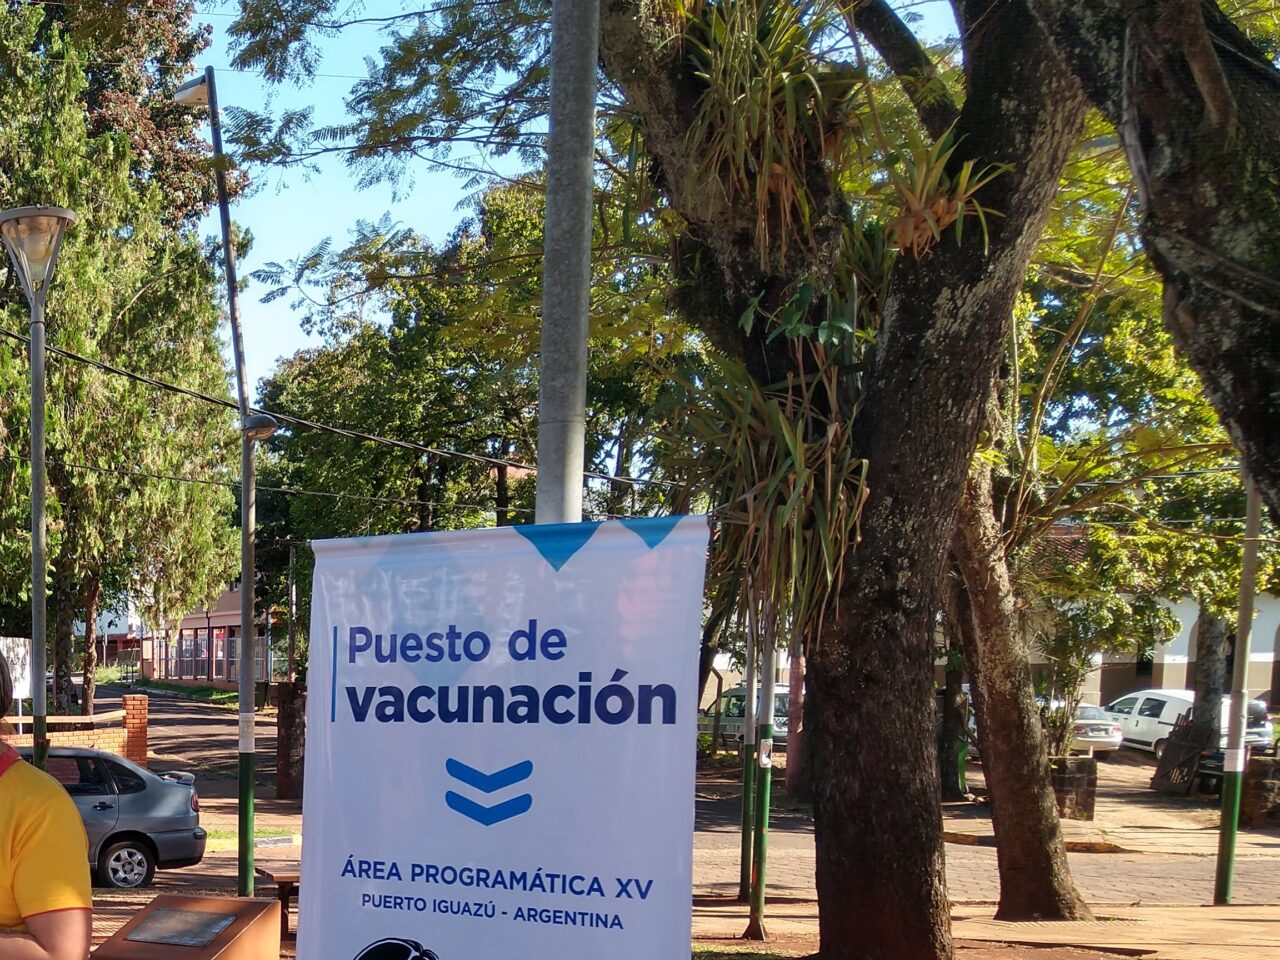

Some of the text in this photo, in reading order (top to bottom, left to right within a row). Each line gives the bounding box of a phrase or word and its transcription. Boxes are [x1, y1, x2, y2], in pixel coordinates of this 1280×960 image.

[348, 618, 568, 664] Puesto de
[346, 668, 677, 725] vacunación
[341, 854, 654, 900] ÁREA PROGRAMÁTICA XV
[362, 894, 427, 912] PUERTO
[432, 898, 495, 919] IGUAZÚ
[514, 906, 624, 930] ARGENTINA
